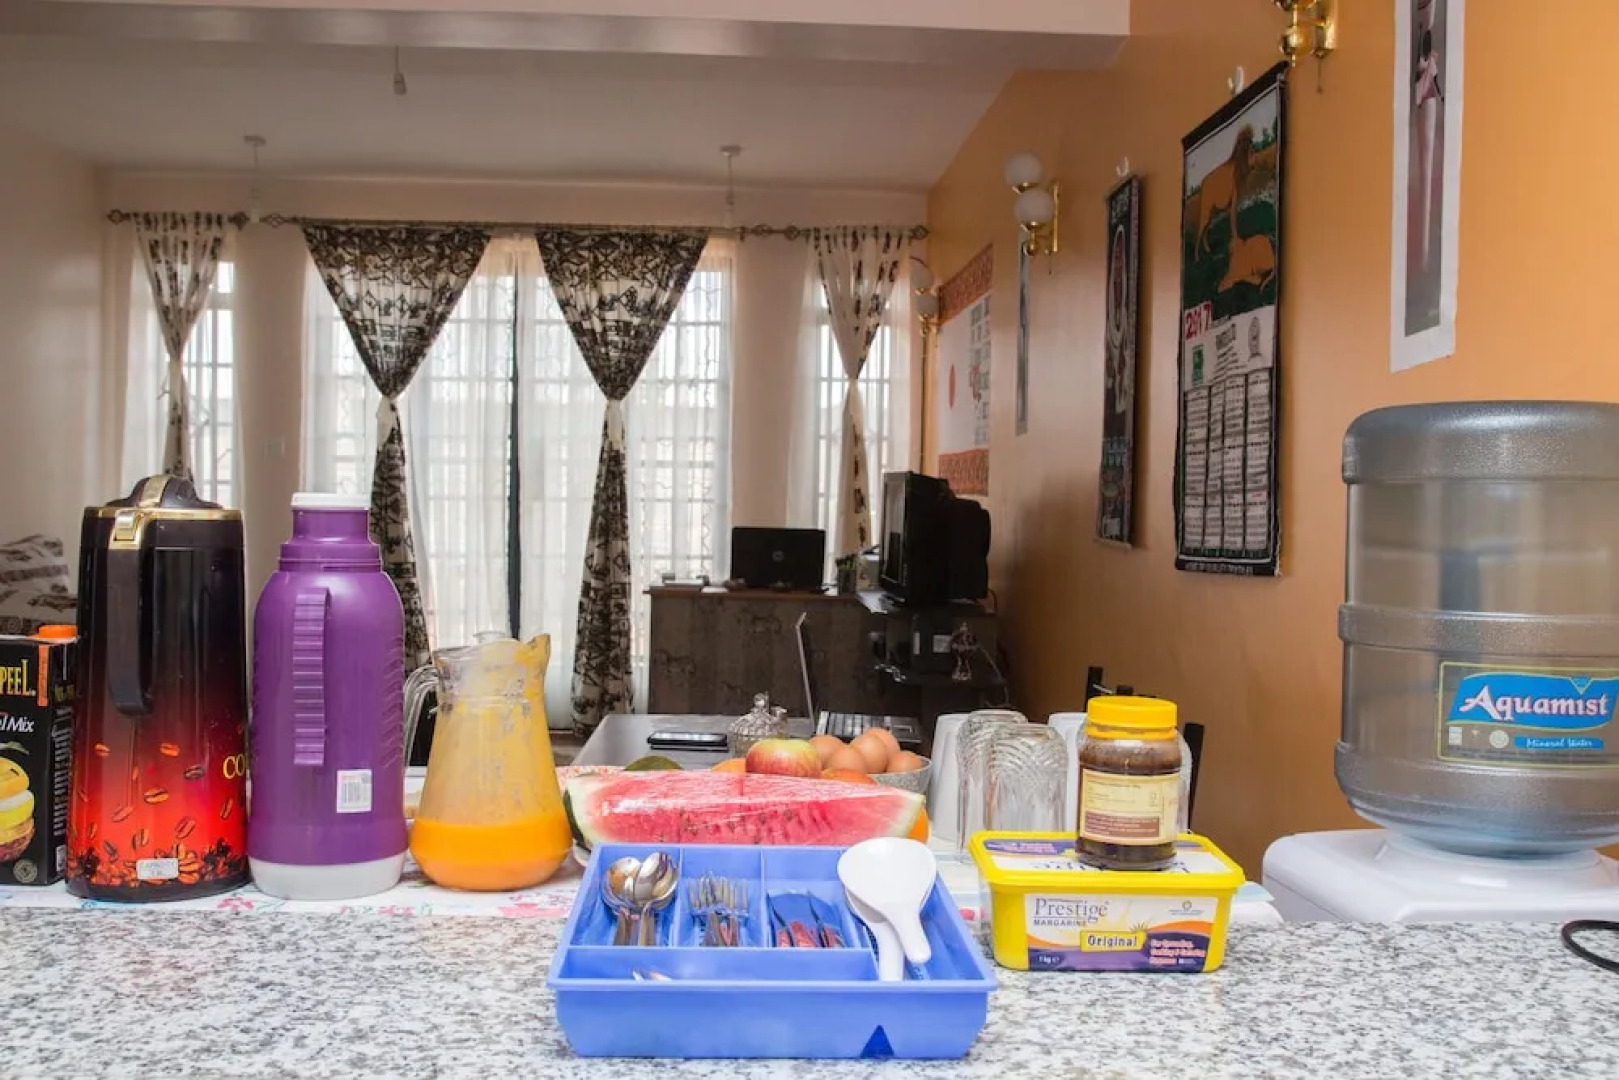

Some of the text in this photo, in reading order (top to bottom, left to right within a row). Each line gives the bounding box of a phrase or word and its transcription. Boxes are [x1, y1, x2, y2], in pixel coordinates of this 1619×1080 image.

[1185, 303, 1211, 340] 2017
[1459, 685, 1608, 721] Aquamist
[7, 717, 34, 732] Mix
[1034, 897, 1108, 923] Prestige
[1033, 918, 1087, 927] MARGARINE
[1087, 935, 1138, 948] Original
